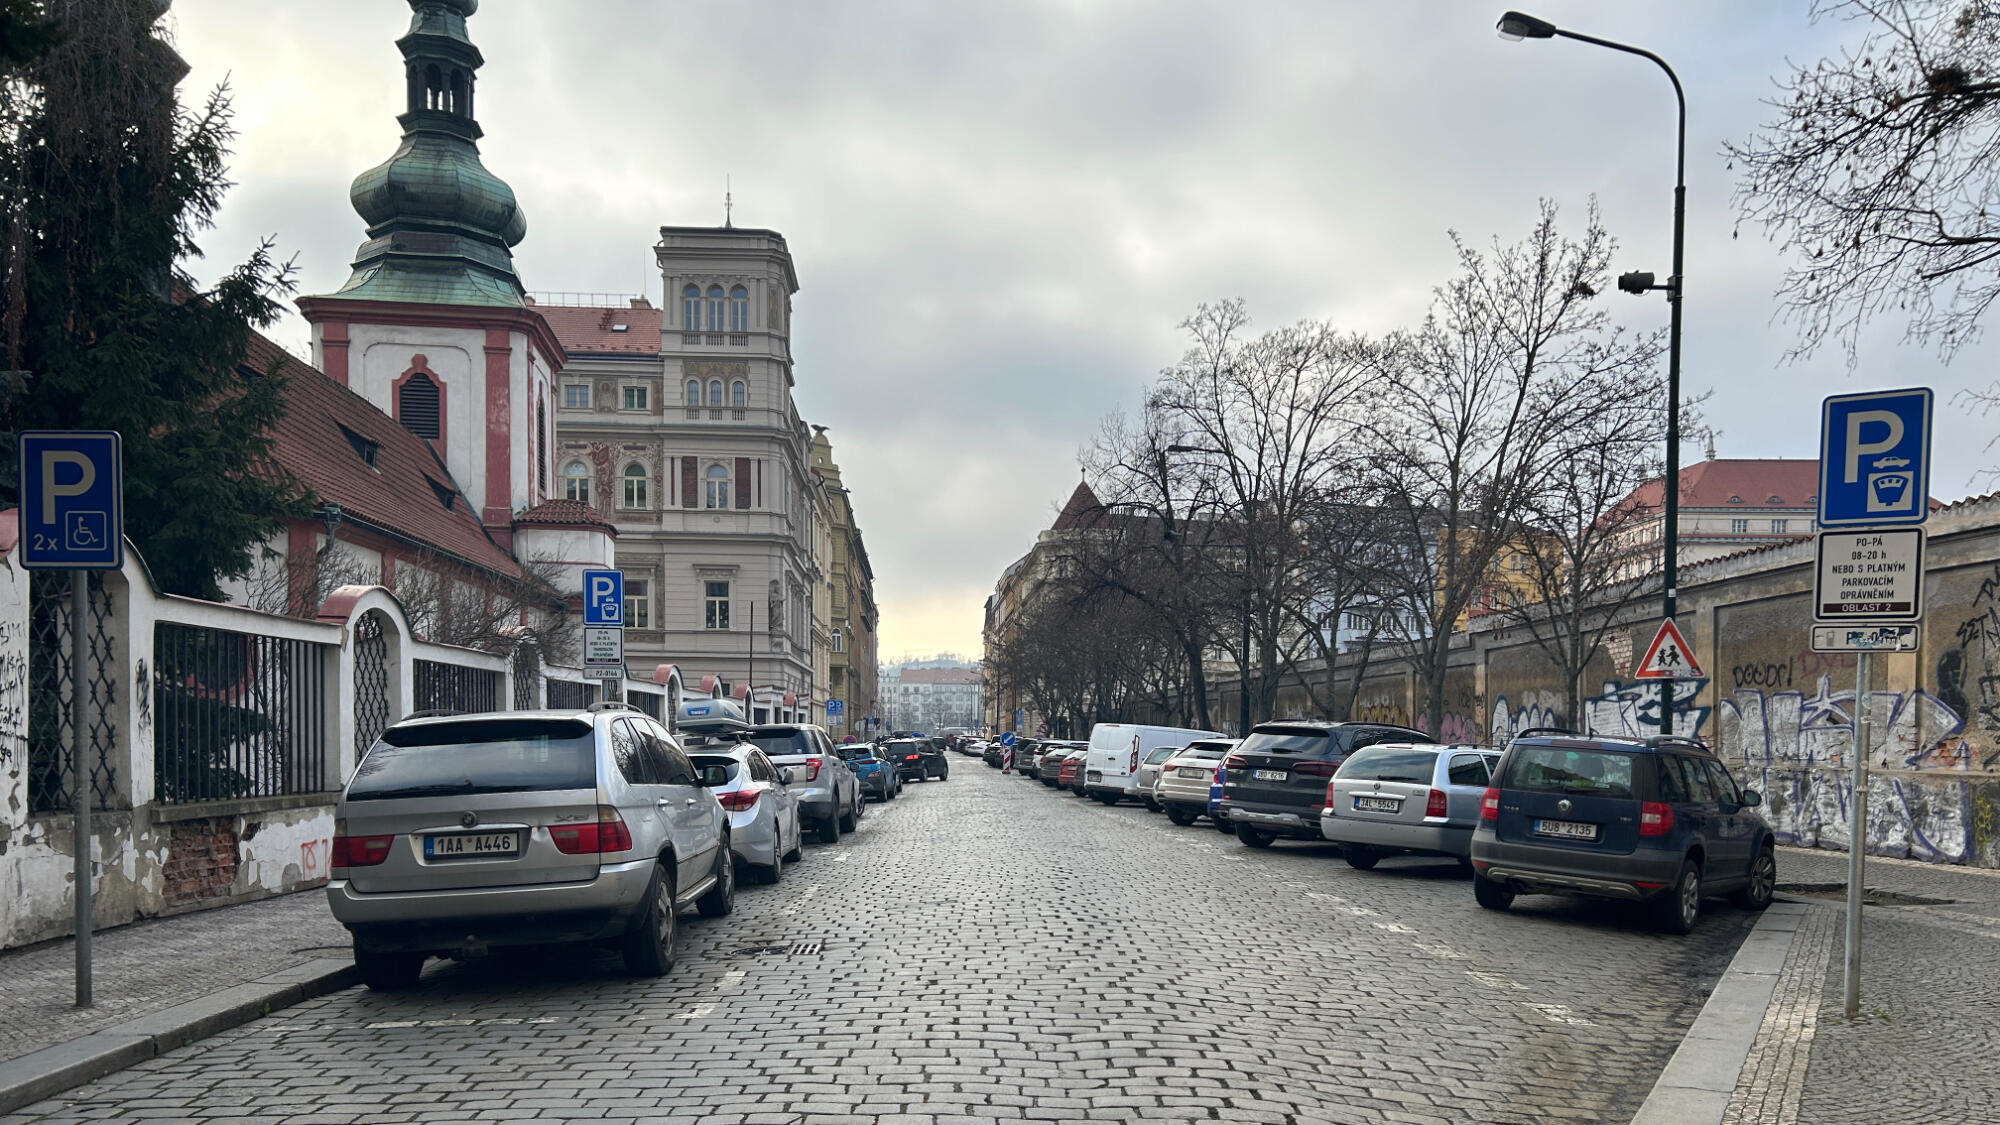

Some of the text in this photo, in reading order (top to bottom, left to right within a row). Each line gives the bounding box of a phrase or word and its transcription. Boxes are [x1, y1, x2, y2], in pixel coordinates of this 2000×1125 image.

[1844, 410, 1905, 484] P
[42, 450, 96, 525] P
[33, 533, 58, 551] 2x
[1856, 535, 1882, 547] PO-PÁ
[1851, 550, 1887, 560] 08-20 h
[1832, 561, 1906, 574] NEBO S PLATNÝM
[1842, 575, 1894, 586] PARKOVACÍM
[592, 576, 615, 608] P
[1840, 588, 1895, 600] OPRÁVNĚNÍM
[1841, 603, 1892, 612] OBLAST 2
[1541, 821, 1592, 836] 5U8 2135
[437, 835, 511, 853] 1AA A446
